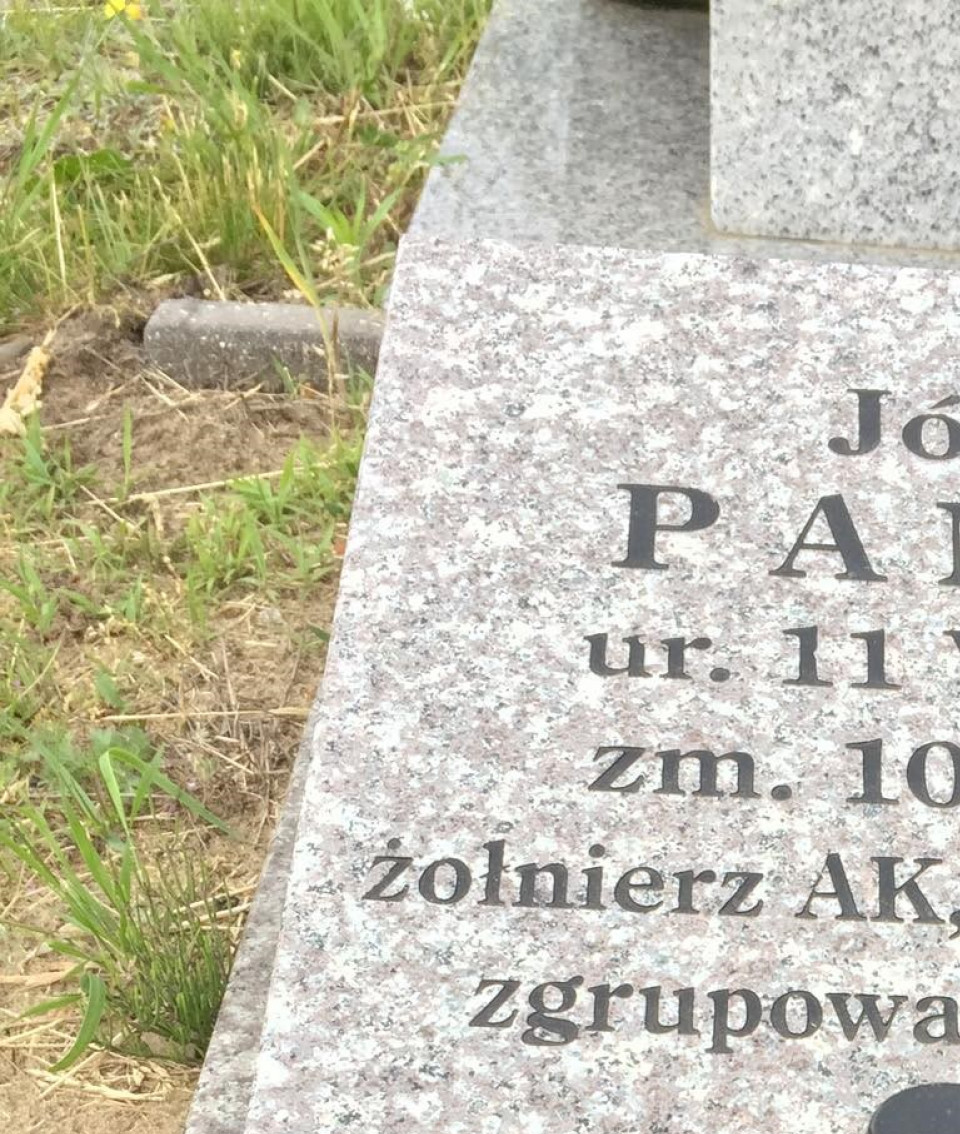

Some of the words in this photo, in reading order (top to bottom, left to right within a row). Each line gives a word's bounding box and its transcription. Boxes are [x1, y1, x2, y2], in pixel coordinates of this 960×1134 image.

[584, 632, 731, 683] ur.
[782, 626, 901, 690] 11
[587, 746, 793, 801] zm.
[361, 838, 765, 917] żołnierz
